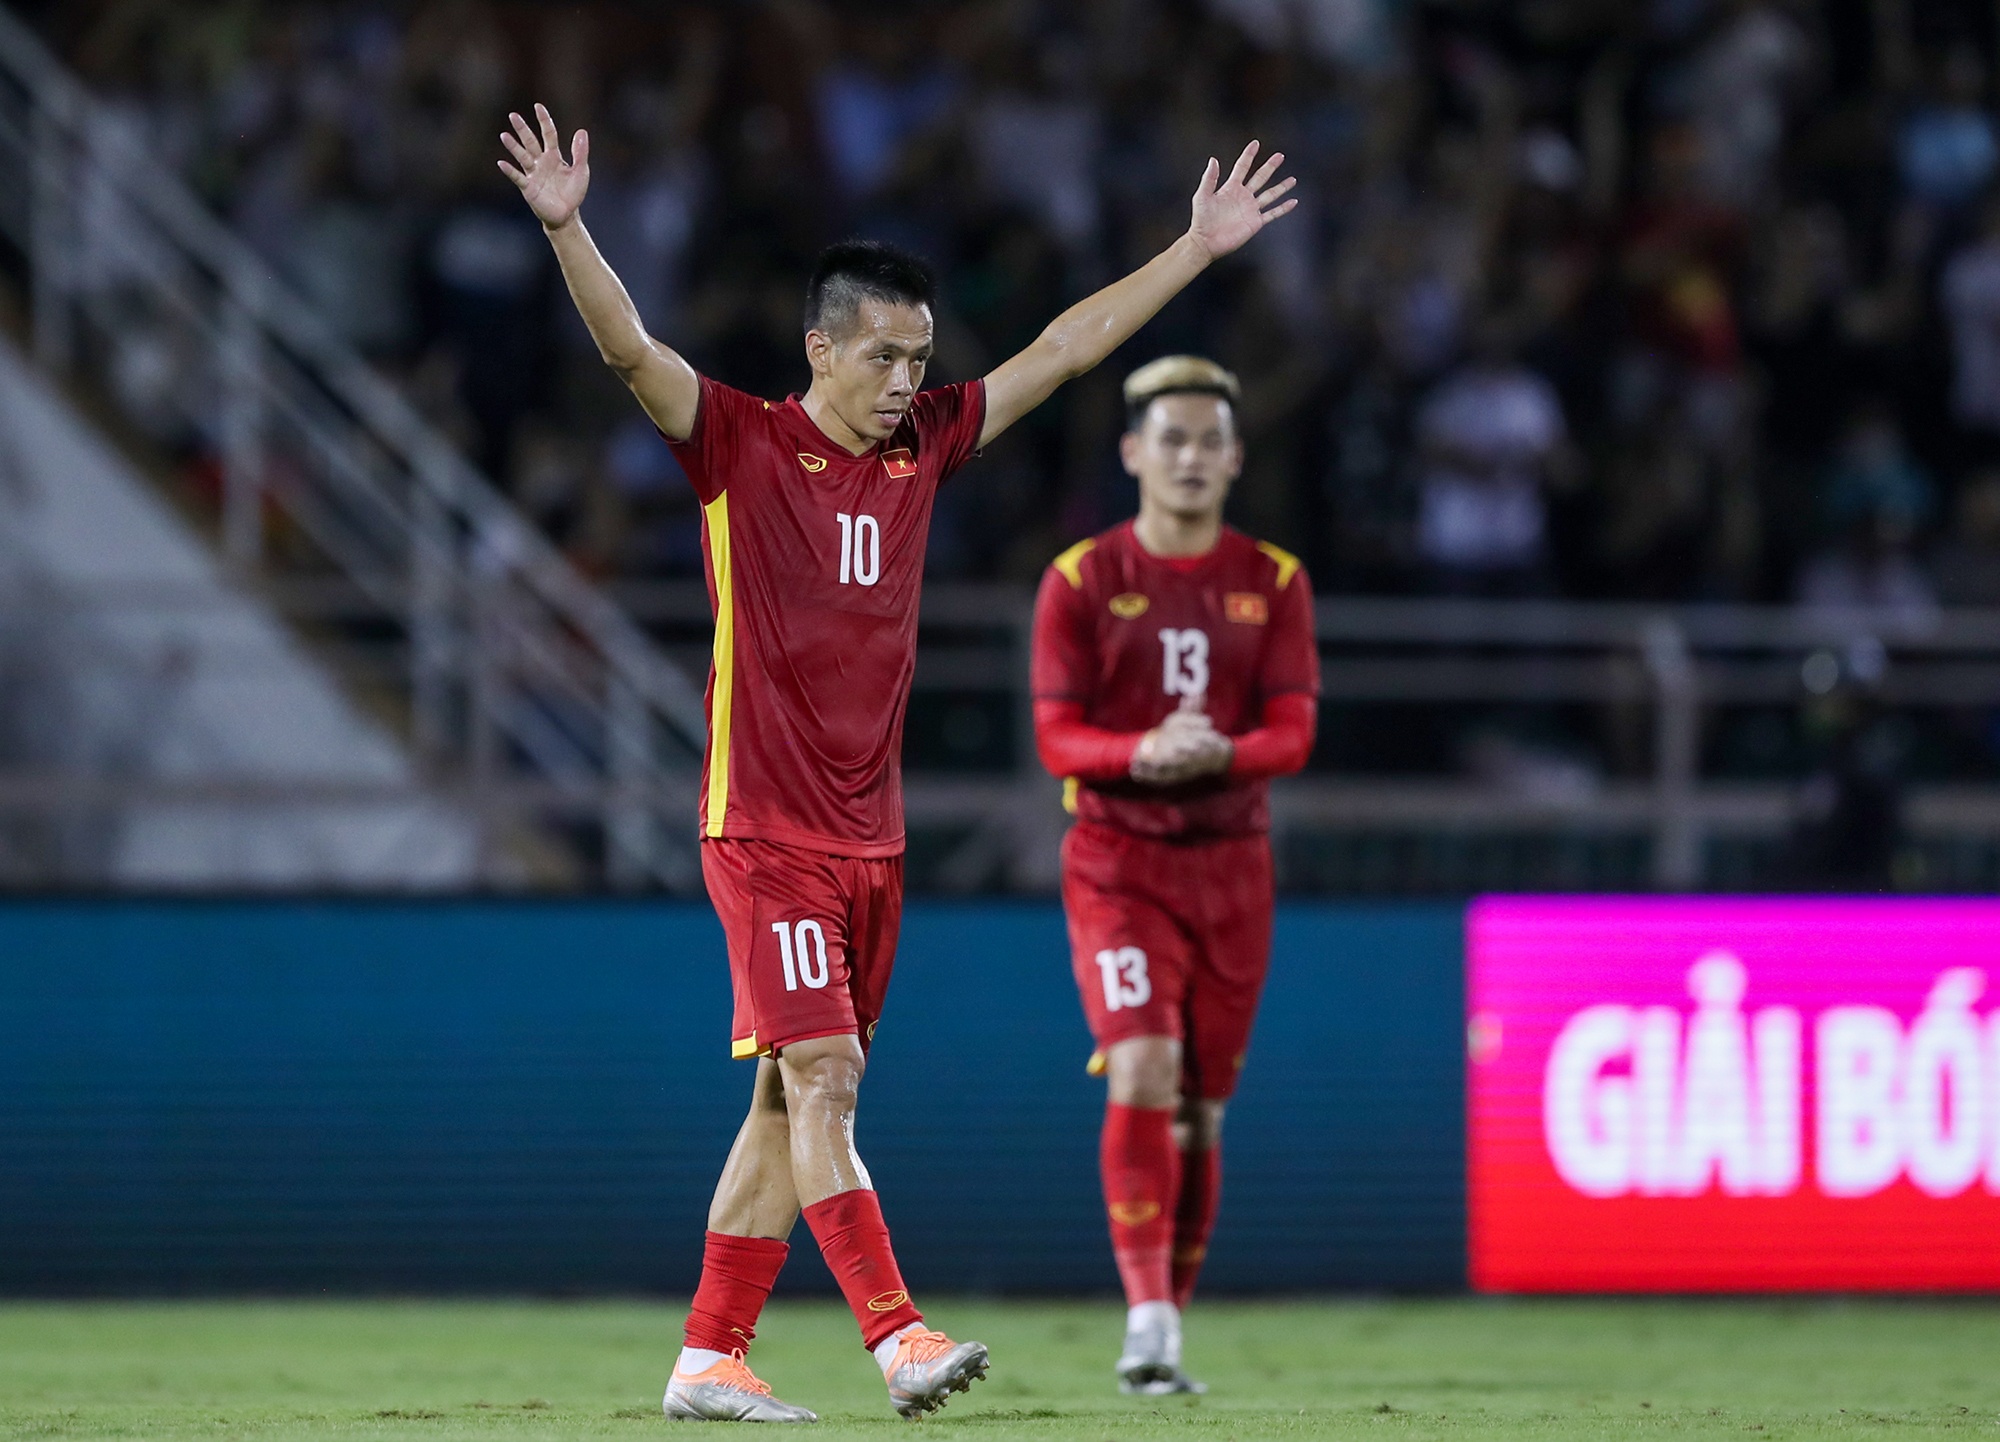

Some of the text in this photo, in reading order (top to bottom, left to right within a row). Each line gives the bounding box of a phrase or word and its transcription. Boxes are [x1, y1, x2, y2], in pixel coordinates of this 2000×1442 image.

[836, 512, 880, 586] 10
[1158, 627, 1211, 697] 13
[771, 919, 829, 992] 10
[1095, 946, 1152, 1012] 13
[1814, 965, 2000, 1199] BÓ
